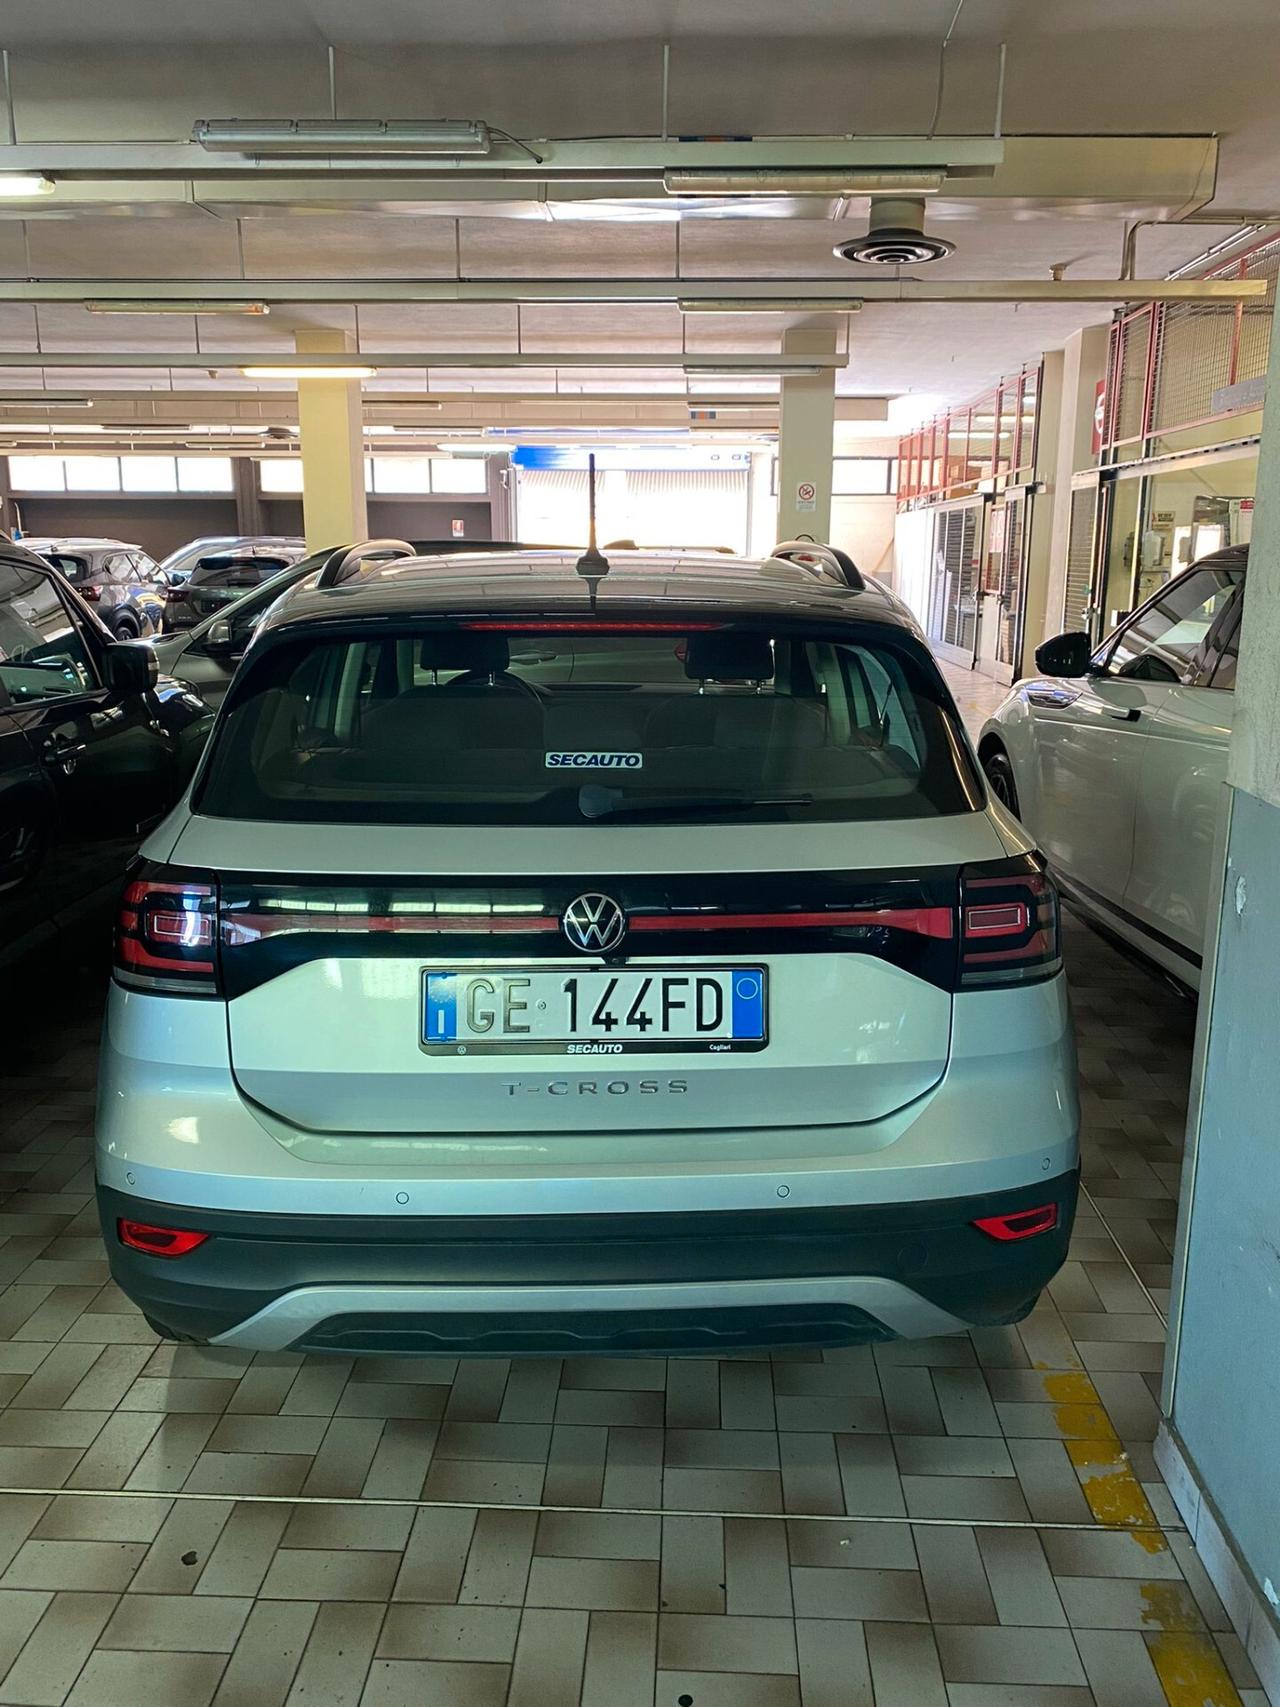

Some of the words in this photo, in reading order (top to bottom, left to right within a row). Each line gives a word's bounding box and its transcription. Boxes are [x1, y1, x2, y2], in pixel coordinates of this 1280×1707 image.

[548, 754, 640, 767] SECAUTO
[466, 978, 531, 1034] GE
[563, 977, 724, 1032] 144FD
[566, 1043, 623, 1054] SECAUTO
[709, 1043, 732, 1052] Cagliari
[501, 1080, 688, 1096] T-CROSS
